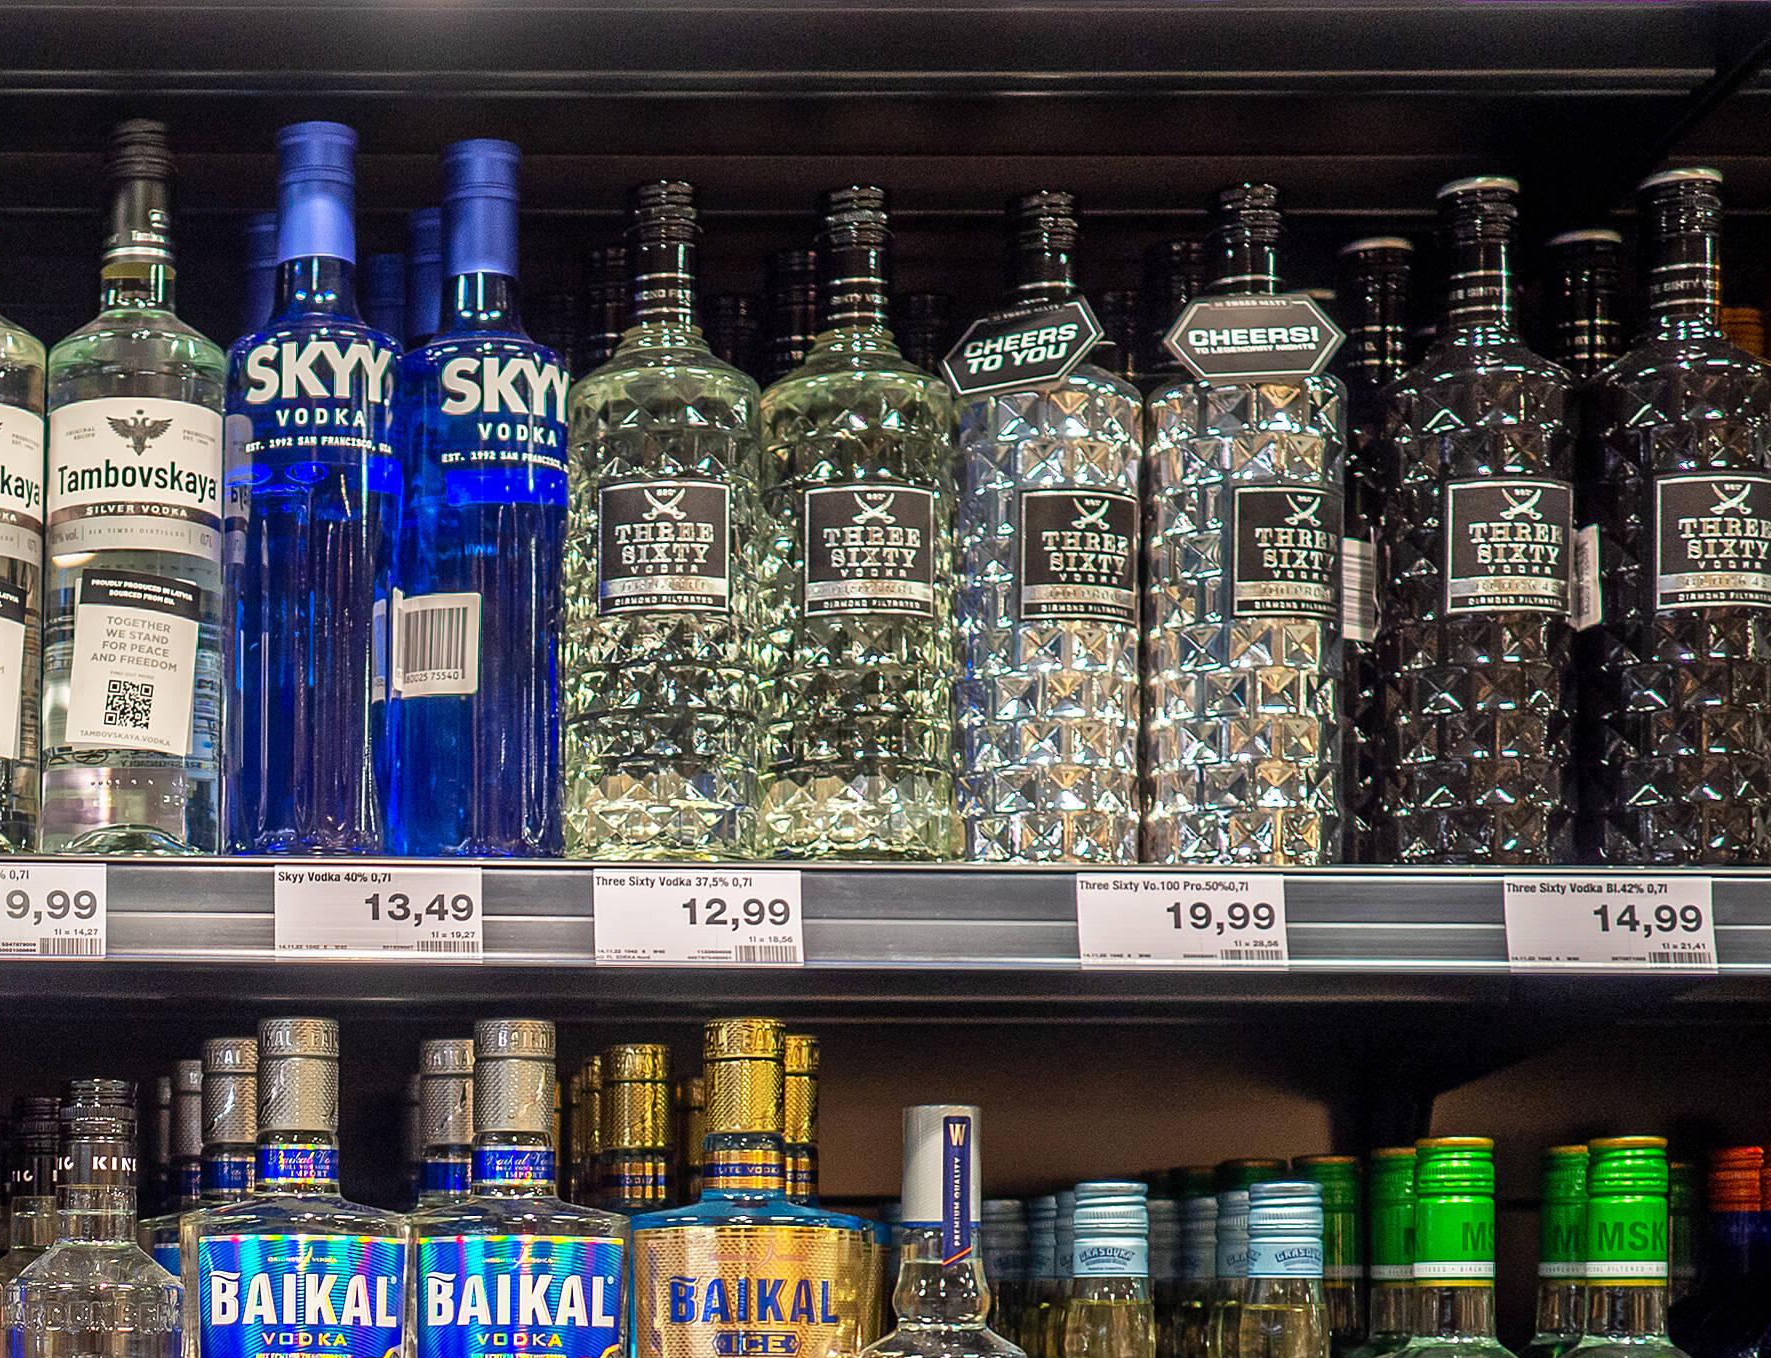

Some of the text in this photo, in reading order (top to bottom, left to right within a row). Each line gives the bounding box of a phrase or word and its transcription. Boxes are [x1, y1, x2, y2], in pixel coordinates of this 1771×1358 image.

[963, 324, 1078, 360] CHEERS
[1188, 326, 1319, 346] CHEERS!
[967, 343, 1068, 374] TO YOU
[245, 341, 391, 405] SKYY
[441, 357, 568, 424] SKYY
[276, 408, 366, 427] VODKA
[245, 443, 265, 453] EST.
[270, 439, 293, 448] 1992
[298, 436, 317, 446] SAN
[478, 423, 557, 447] VODKA
[57, 461, 217, 503] Tambovskaya
[615, 523, 715, 544] THREE
[823, 526, 922, 548] THREE
[1468, 522, 1563, 544] THREE
[621, 544, 711, 565] SIXTY
[831, 548, 918, 569] SIXTY
[1476, 543, 1560, 564] SIXTY
[278, 871, 305, 884] Skyy
[308, 871, 342, 882] Vodka
[344, 871, 368, 882] 40%
[1079, 880, 1110, 892] Three
[1113, 880, 1141, 894] Sixty
[1142, 880, 1180, 892] Vo.100
[5, 889, 97, 926] 9,99
[364, 892, 475, 929] 13,49
[682, 896, 791, 932] 12,99
[1166, 901, 1276, 936] 19,99
[1592, 903, 1704, 938] 14,99
[261, 1332, 349, 1348] VODKA
[732, 1336, 786, 1352] ICE
